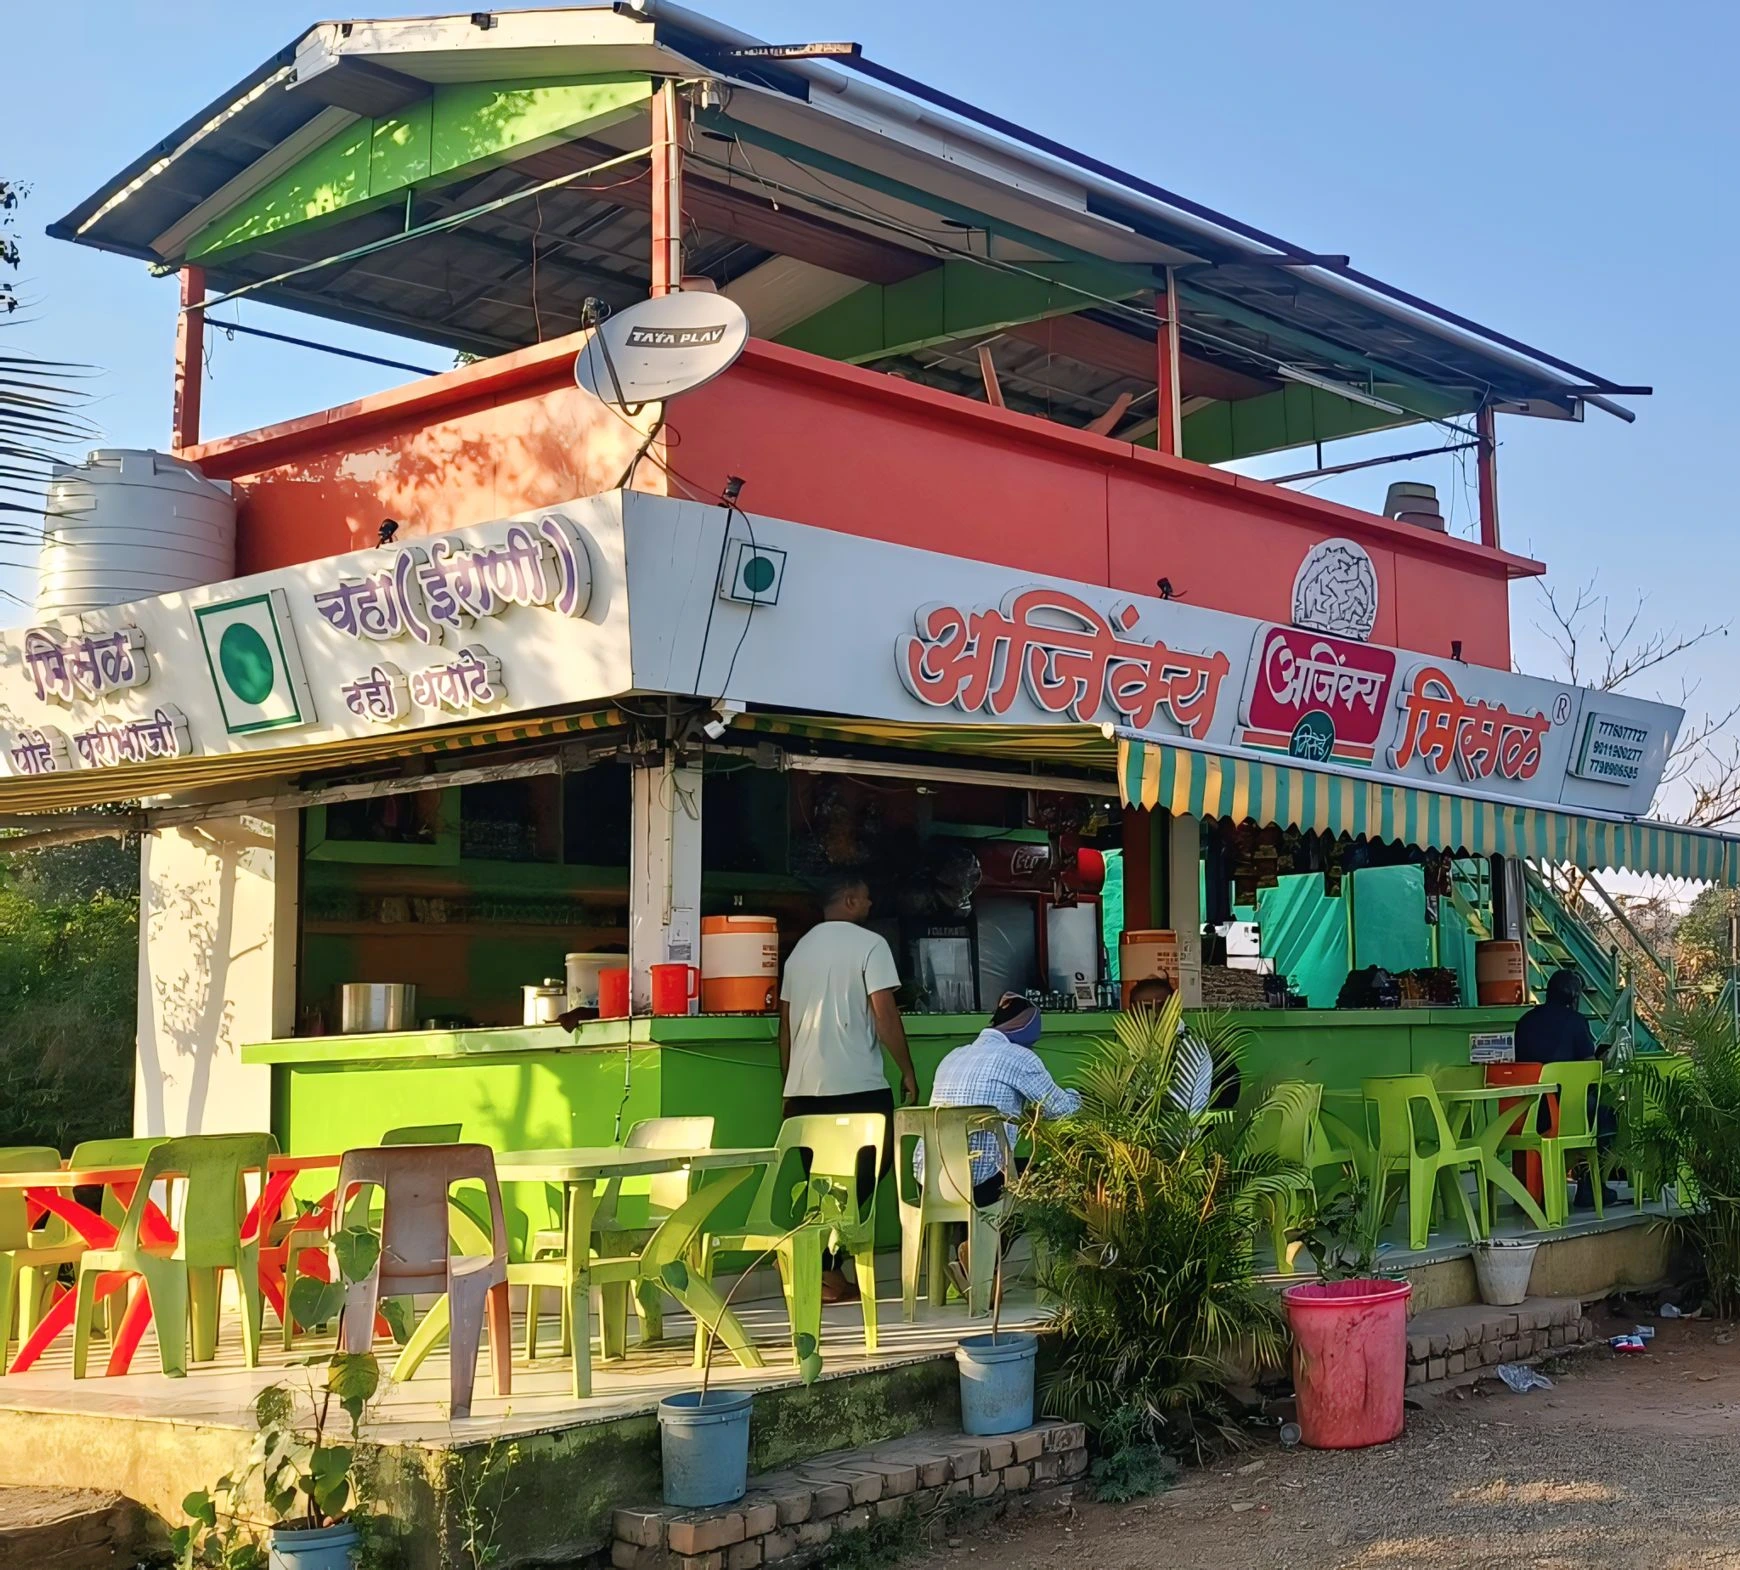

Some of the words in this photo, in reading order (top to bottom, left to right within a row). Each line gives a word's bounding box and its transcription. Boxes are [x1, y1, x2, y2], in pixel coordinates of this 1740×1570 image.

[631, 331, 675, 344] TATA
[680, 329, 724, 343] PLAY
[25, 632, 134, 701] मिसळ
[341, 666, 396, 719] दही
[908, 589, 1230, 740] अजिंक्य
[1265, 635, 1387, 716] अजिंक्य
[1395, 667, 1551, 781] मिसळ
